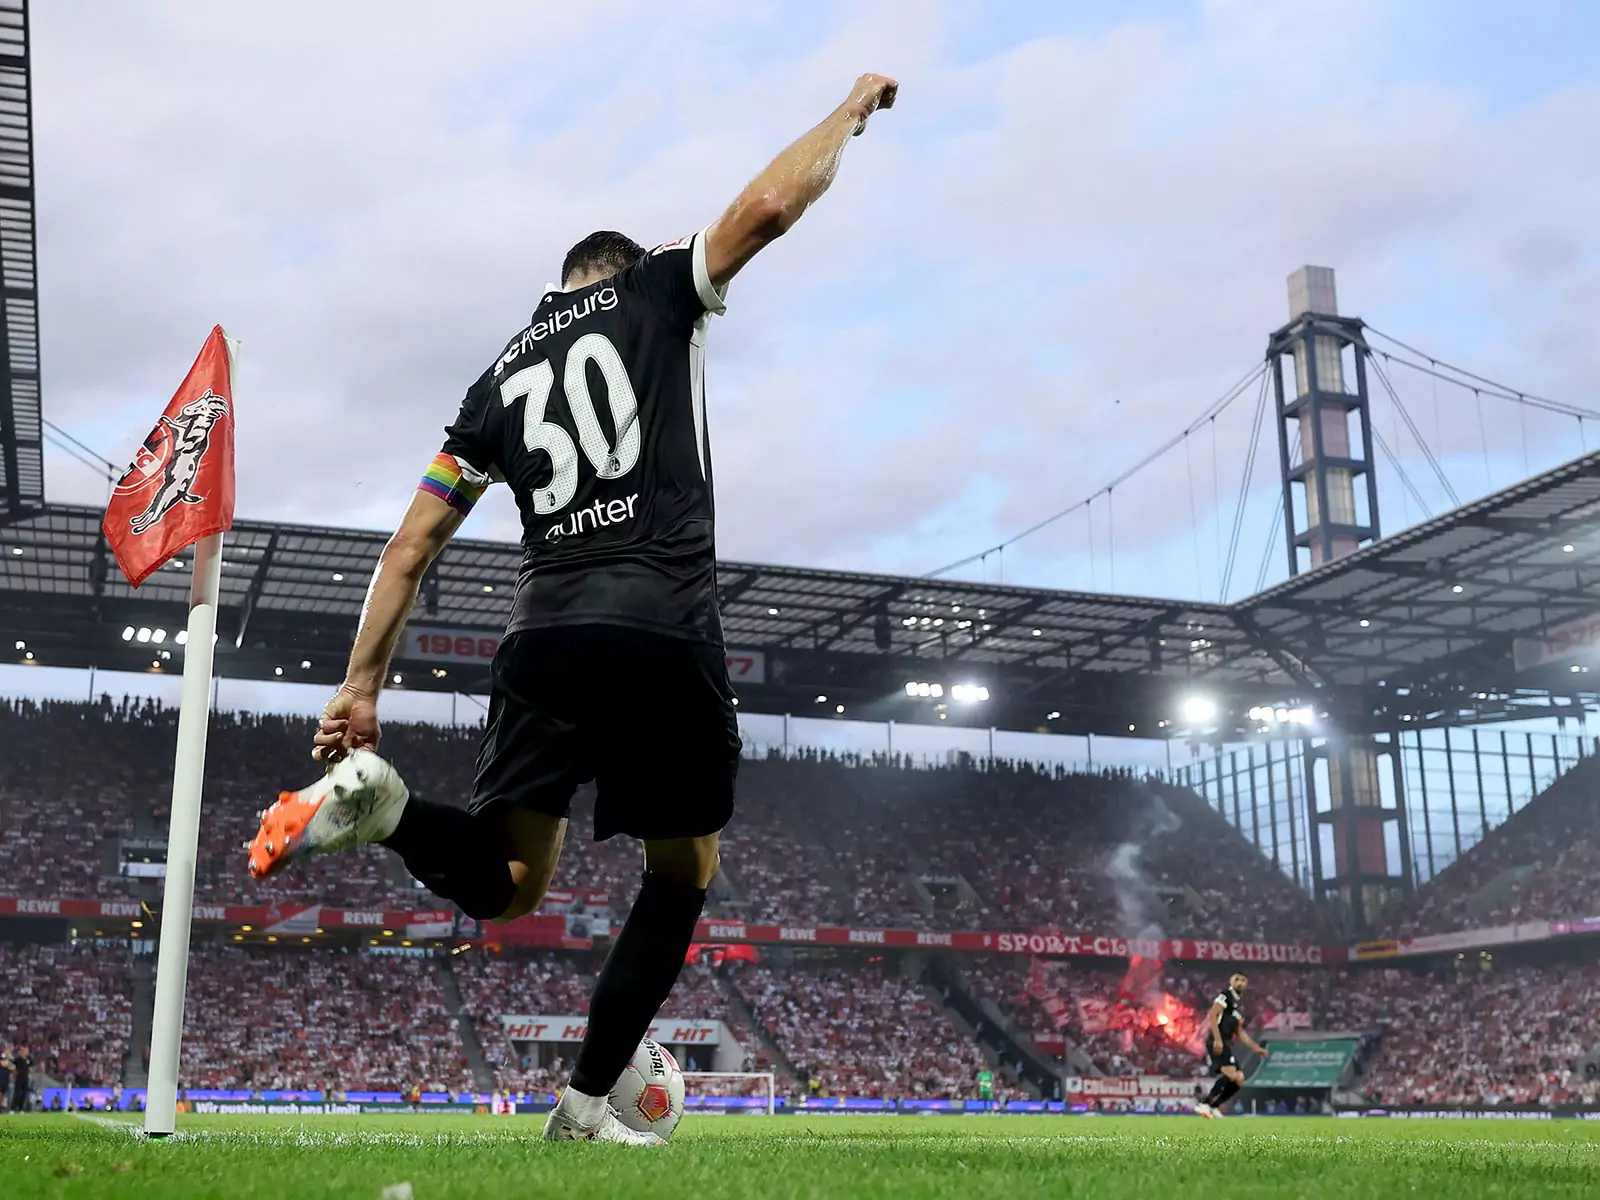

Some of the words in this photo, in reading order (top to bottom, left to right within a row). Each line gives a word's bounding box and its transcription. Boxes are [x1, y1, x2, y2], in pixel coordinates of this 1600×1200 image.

[499, 333, 641, 515] 30
[16, 899, 60, 915] REWE
[191, 906, 226, 920] EWE
[343, 911, 385, 925] REWE
[709, 924, 747, 938] REWE
[779, 927, 817, 941] REWE
[849, 930, 885, 944] REWE
[917, 932, 952, 946] REWE
[1193, 940, 1322, 964] FREIBURG
[507, 1023, 550, 1039] HIT
[561, 1024, 589, 1040] HI
[671, 1027, 714, 1042] HIT
